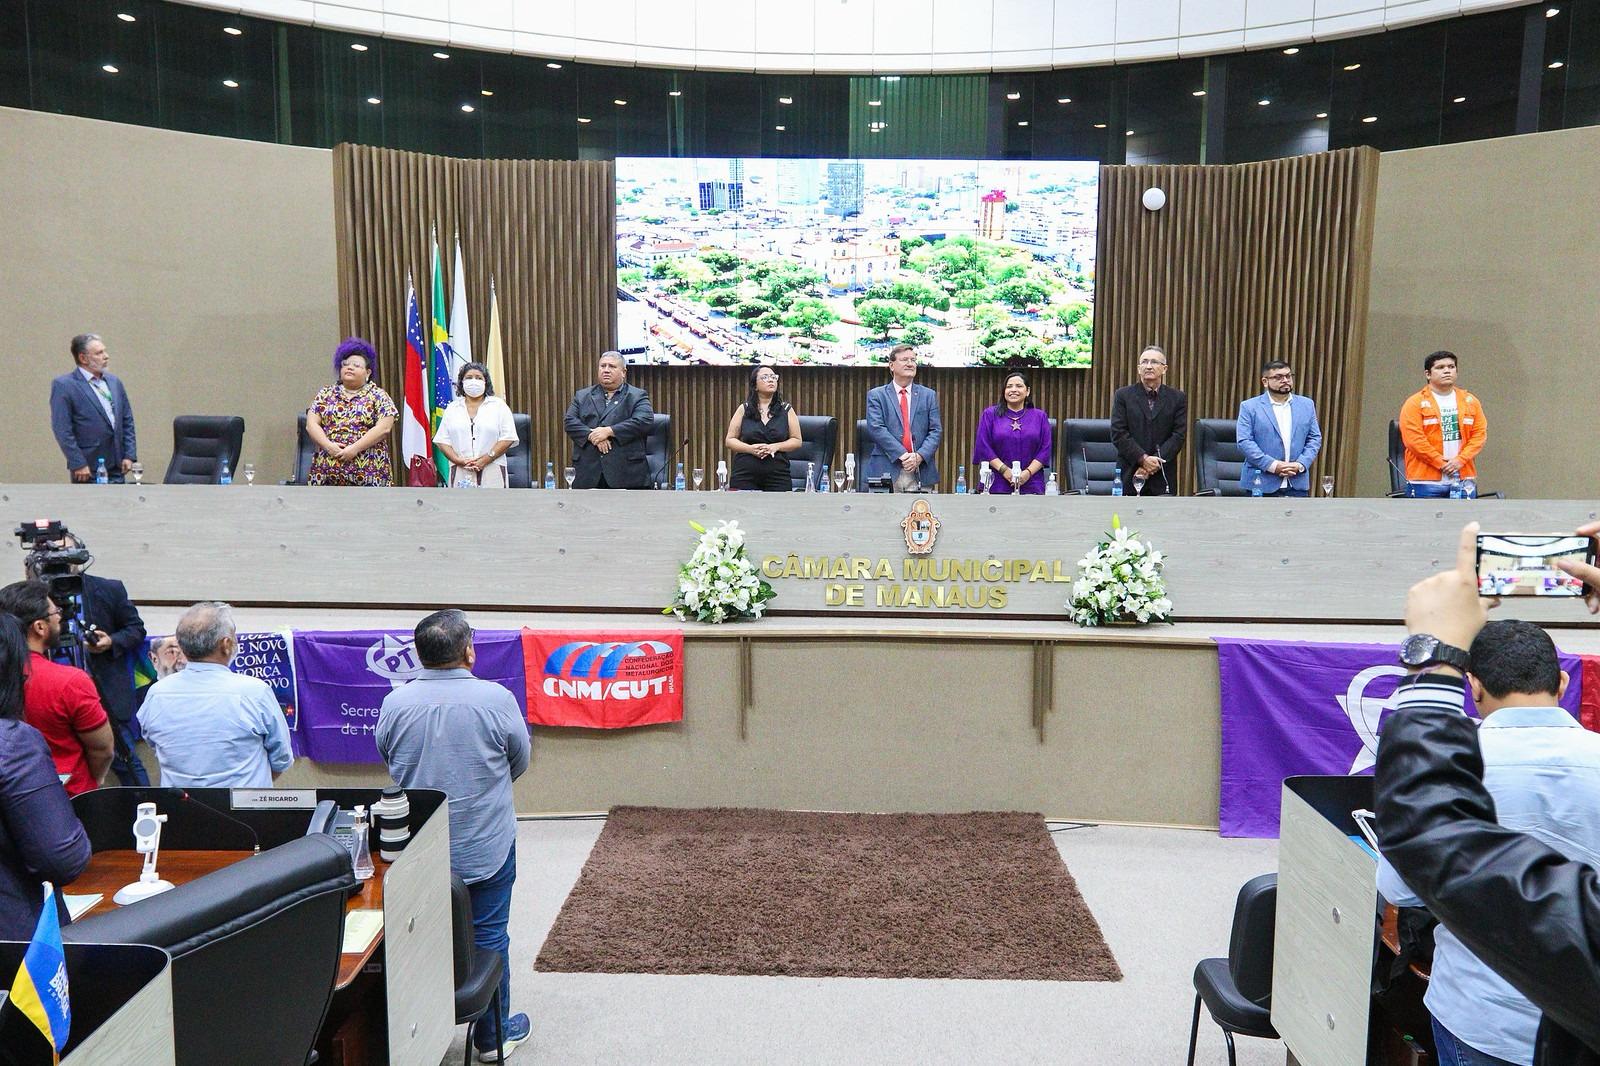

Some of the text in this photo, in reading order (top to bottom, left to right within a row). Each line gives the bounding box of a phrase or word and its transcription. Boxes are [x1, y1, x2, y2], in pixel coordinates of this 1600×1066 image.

[762, 552, 1072, 583] CÂMARA MUNICIPAL
[825, 583, 1009, 608] DE MANAUS
[249, 639, 287, 653] NOVO
[234, 652, 281, 668] COM A
[385, 647, 415, 673] PT
[625, 659, 674, 671] NACIONAL DOS
[543, 675, 668, 701] CNM/CUT
[340, 702, 380, 718] Secre
[341, 722, 358, 735] de
